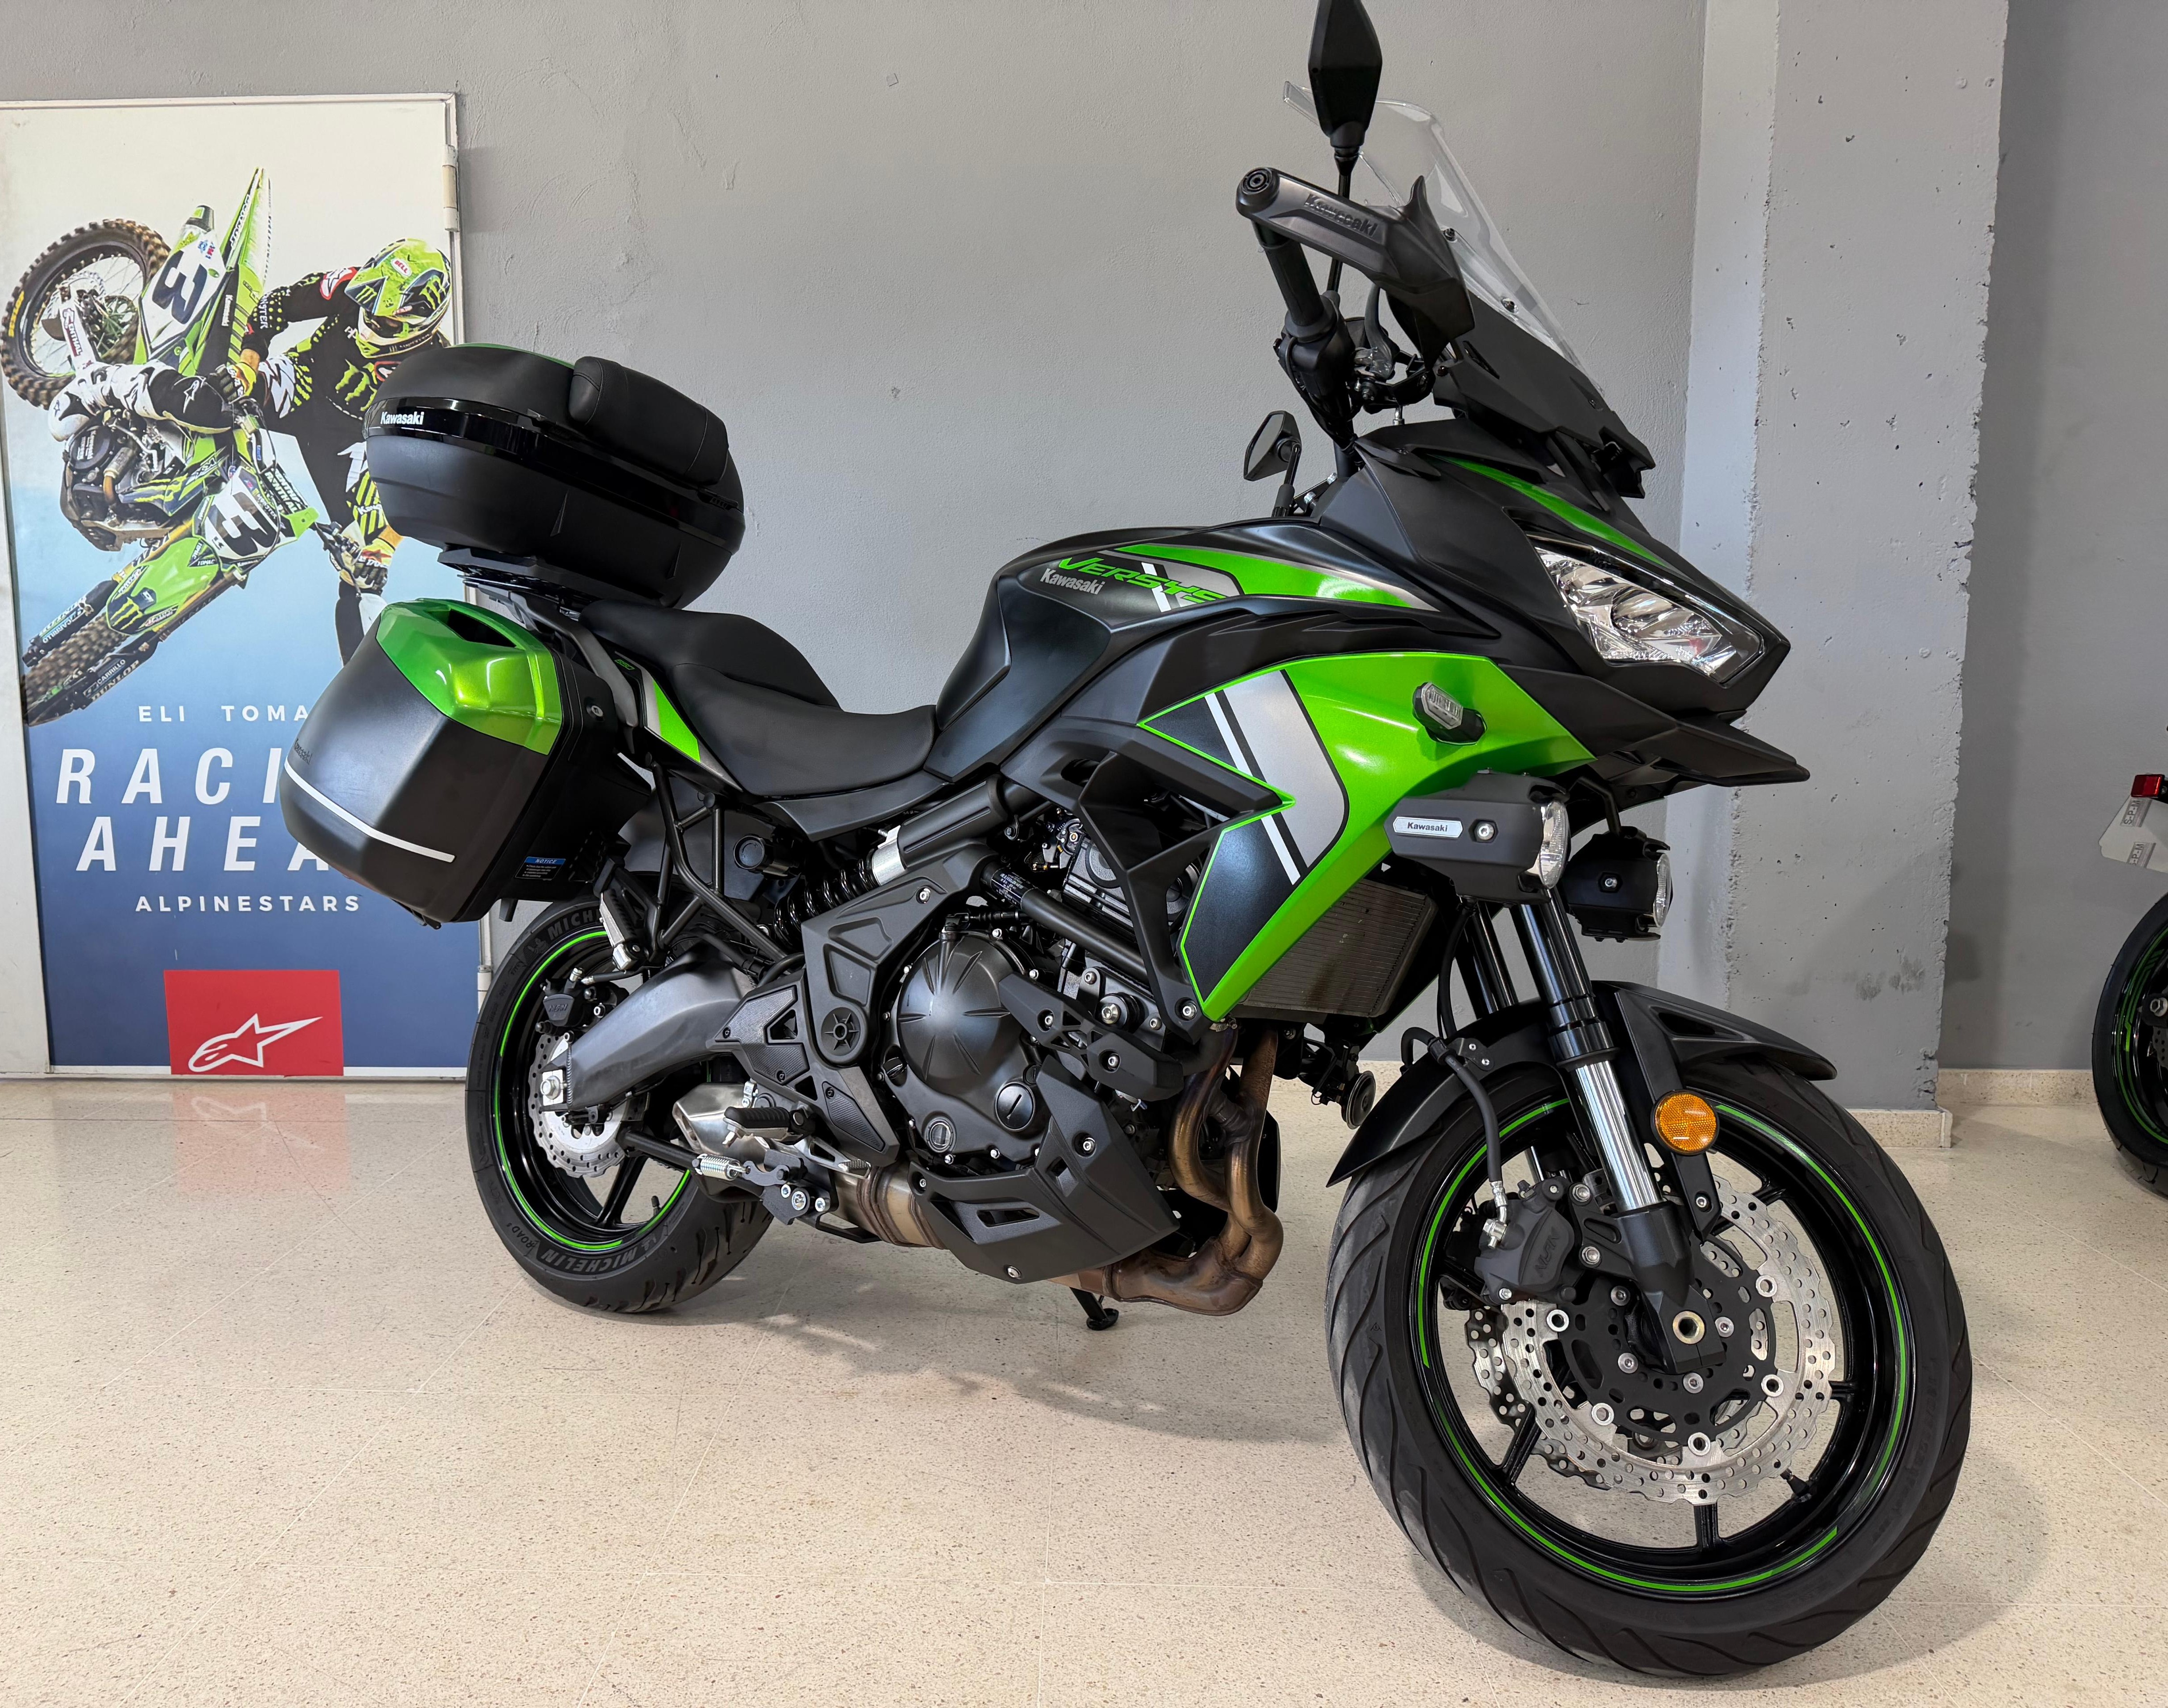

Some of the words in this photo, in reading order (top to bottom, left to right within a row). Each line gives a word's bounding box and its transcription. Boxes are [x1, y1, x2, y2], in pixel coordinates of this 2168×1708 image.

[1304, 194, 1378, 236] Kawasaki
[394, 260, 408, 274] BELL
[380, 411, 424, 425] Kawasaki
[1040, 568, 1105, 595] Kawasaki
[1058, 557, 1227, 603] VERSYS
[43, 620, 72, 643] CARRILLO
[91, 660, 139, 701] DUNLOP
[97, 659, 125, 685] CARRILLO
[139, 705, 184, 722] ELI
[221, 705, 308, 721] TOMA
[56, 747, 282, 805] RACI
[1408, 822, 1447, 832] Kawasaki
[136, 896, 359, 912] ALPINESTARS
[512, 1225, 535, 1249] ROAD
[540, 1247, 638, 1272] MICHELIN
